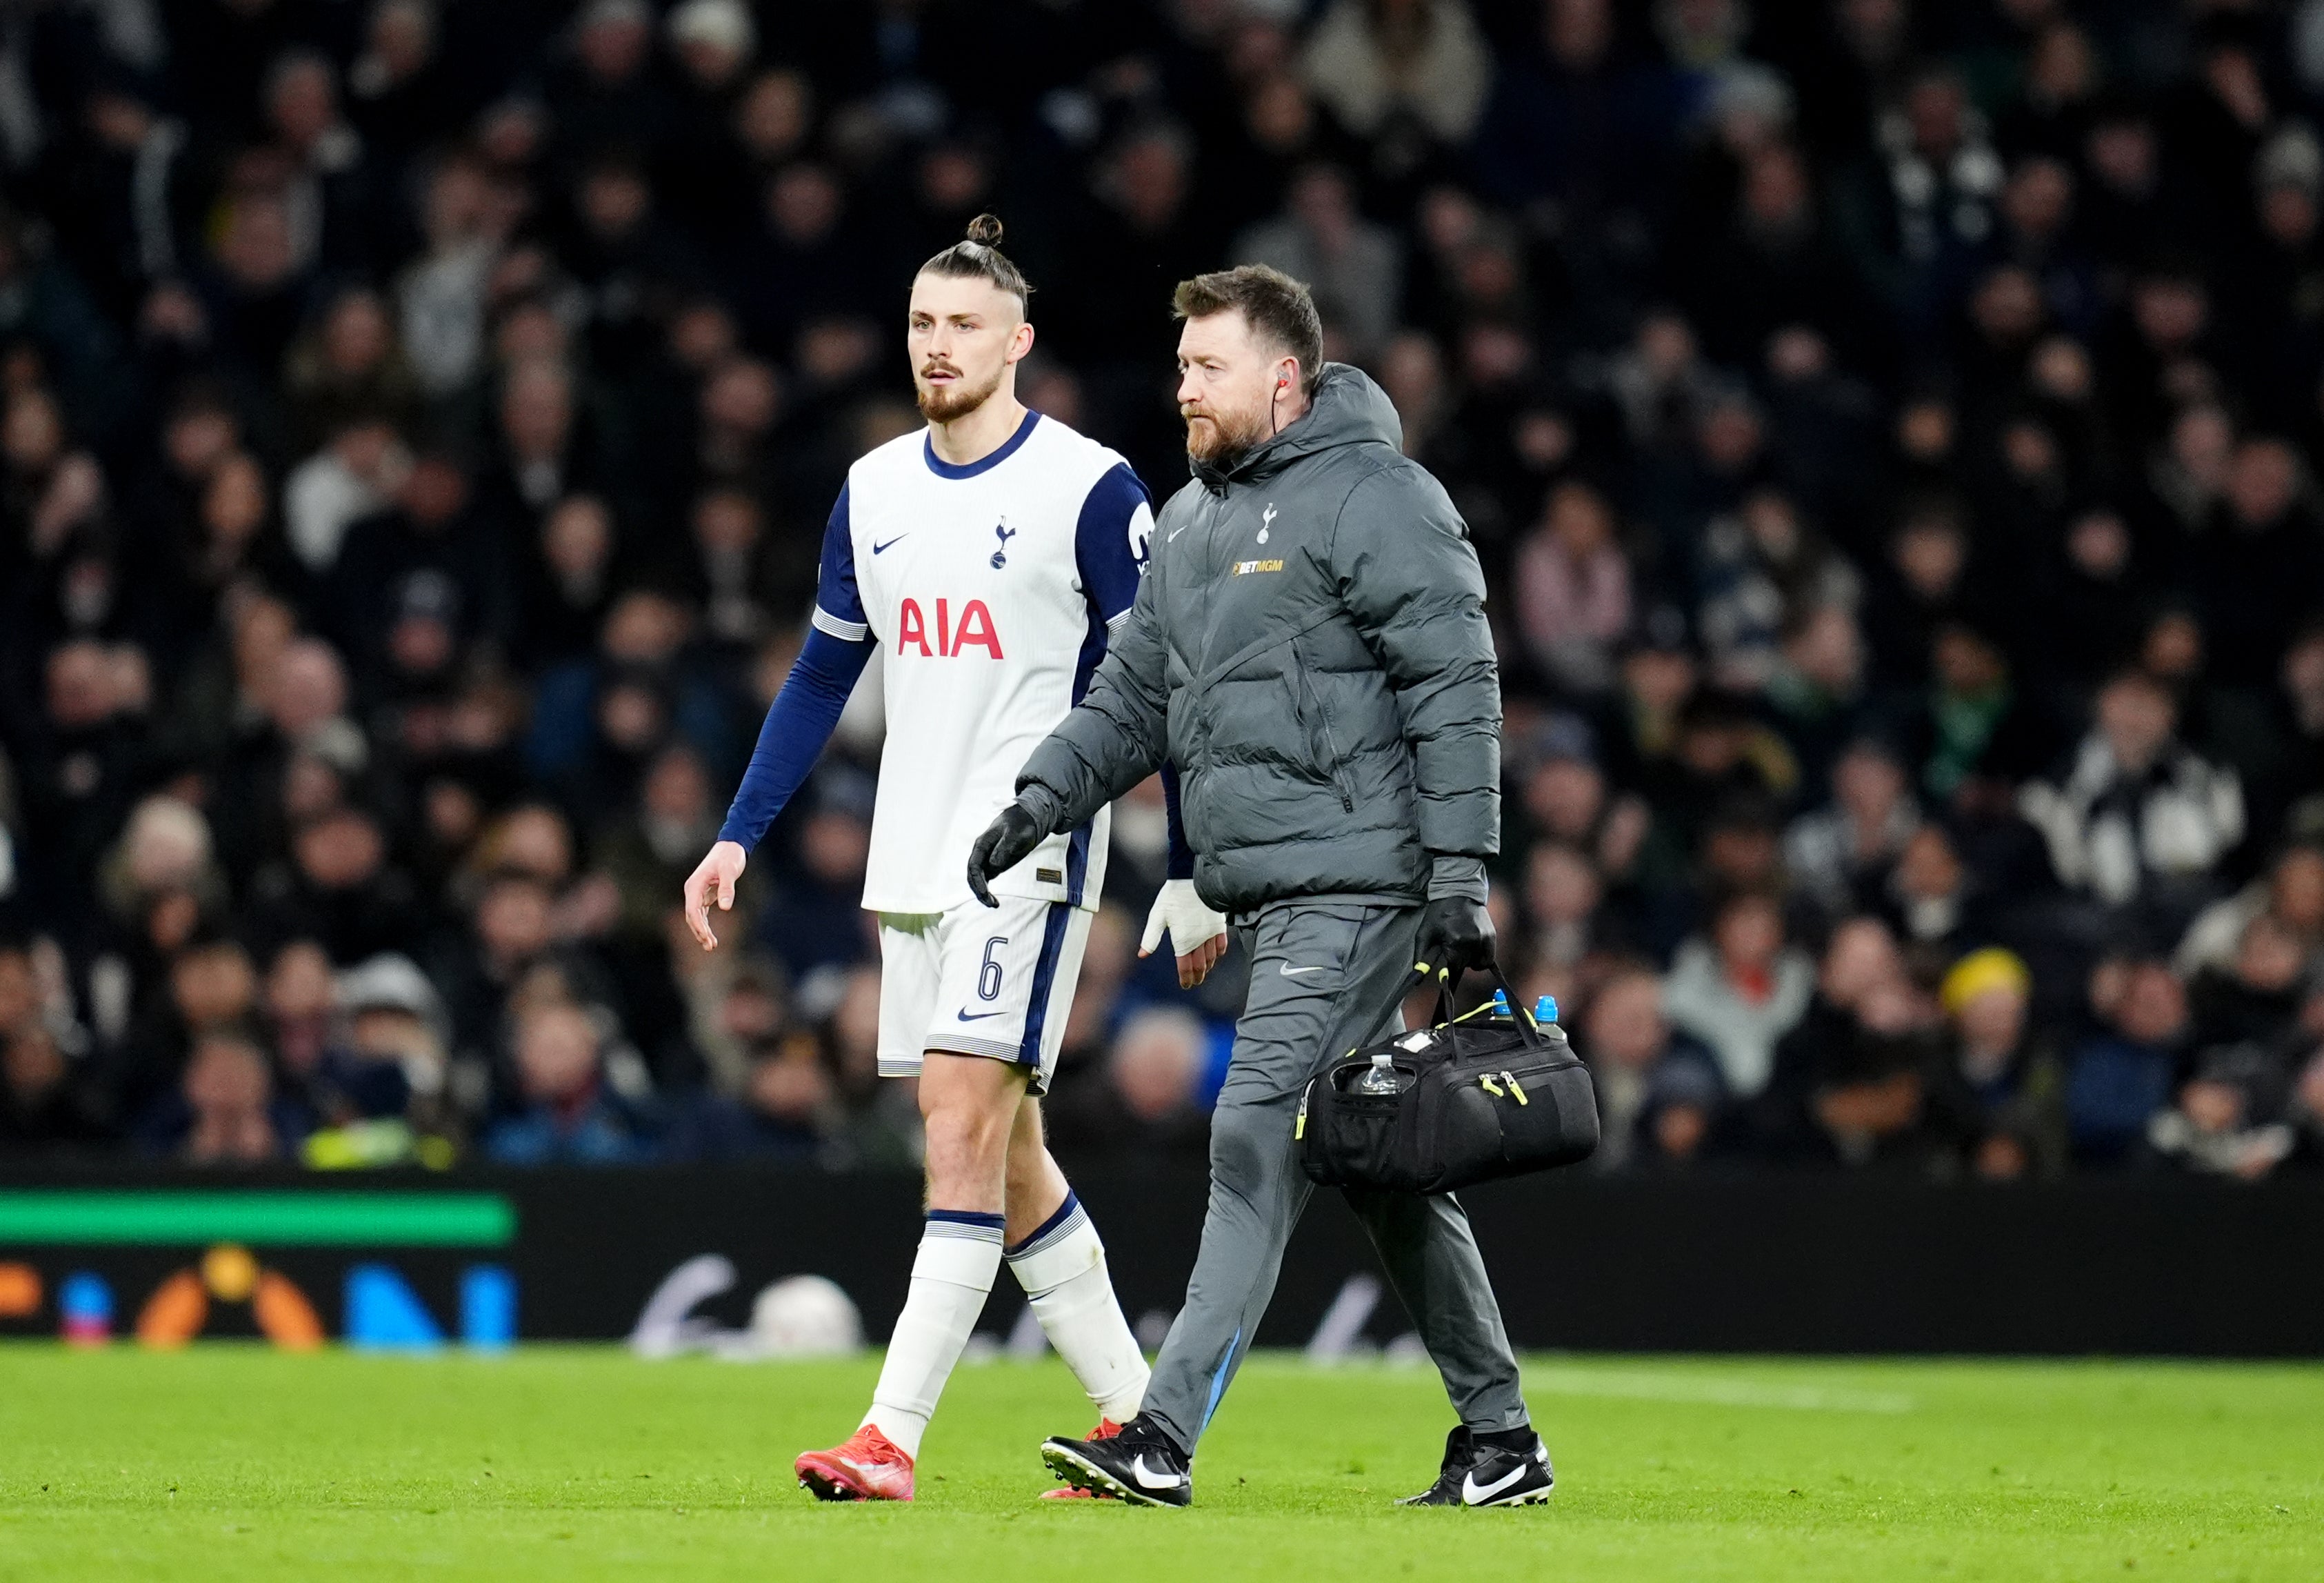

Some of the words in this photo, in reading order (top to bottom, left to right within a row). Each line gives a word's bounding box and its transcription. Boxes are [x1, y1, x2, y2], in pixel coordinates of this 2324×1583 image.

[1239, 559, 1283, 575] BETMGM
[899, 597, 1004, 660] AIA
[977, 936, 1009, 1002] 6
